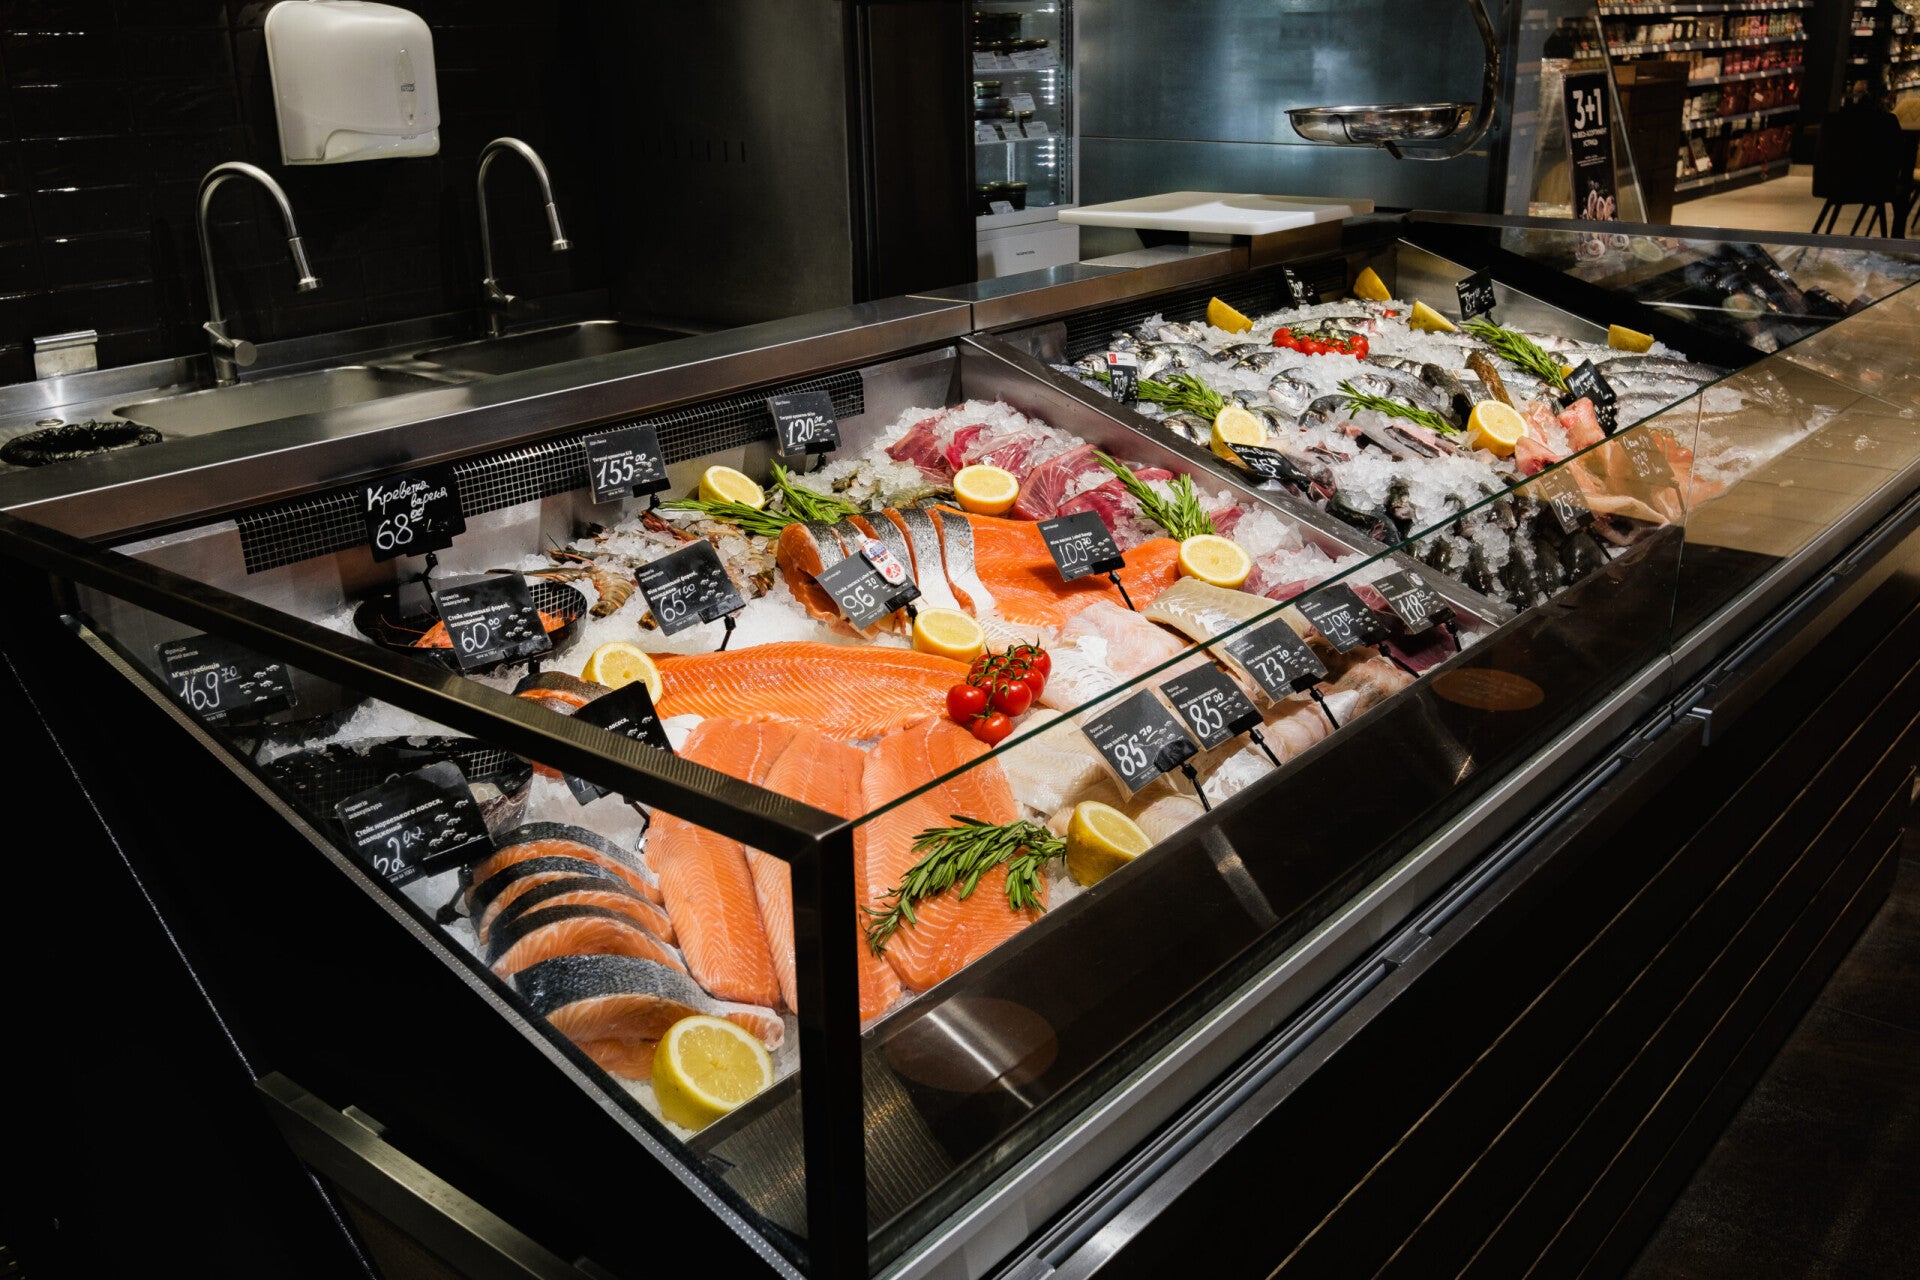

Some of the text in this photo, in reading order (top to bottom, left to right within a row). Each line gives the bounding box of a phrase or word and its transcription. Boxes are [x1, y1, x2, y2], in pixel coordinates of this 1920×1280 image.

[1572, 88, 1603, 129] 3+1
[787, 418, 814, 446] 120
[597, 453, 647, 490] 155 00
[376, 507, 424, 550] 68 00
[1059, 540, 1088, 568] 109
[447, 601, 510, 621] Стейк норвезької форелі,
[660, 584, 695, 621] 65 00
[842, 585, 875, 617] 96
[1399, 594, 1426, 624] 118
[461, 617, 500, 653] 60 00
[1321, 614, 1351, 642] 49
[171, 660, 220, 679] М'ясо гребінців
[1254, 656, 1286, 688] 73
[180, 665, 237, 710] 169 70
[1189, 696, 1223, 738] 85
[1212, 692, 1224, 703] 00
[1114, 734, 1148, 776] 85
[344, 800, 368, 813] Норвегія
[348, 802, 383, 820] аквакультура
[355, 798, 444, 838] Стейк норвезького лосося,
[358, 822, 402, 846] охолоджений
